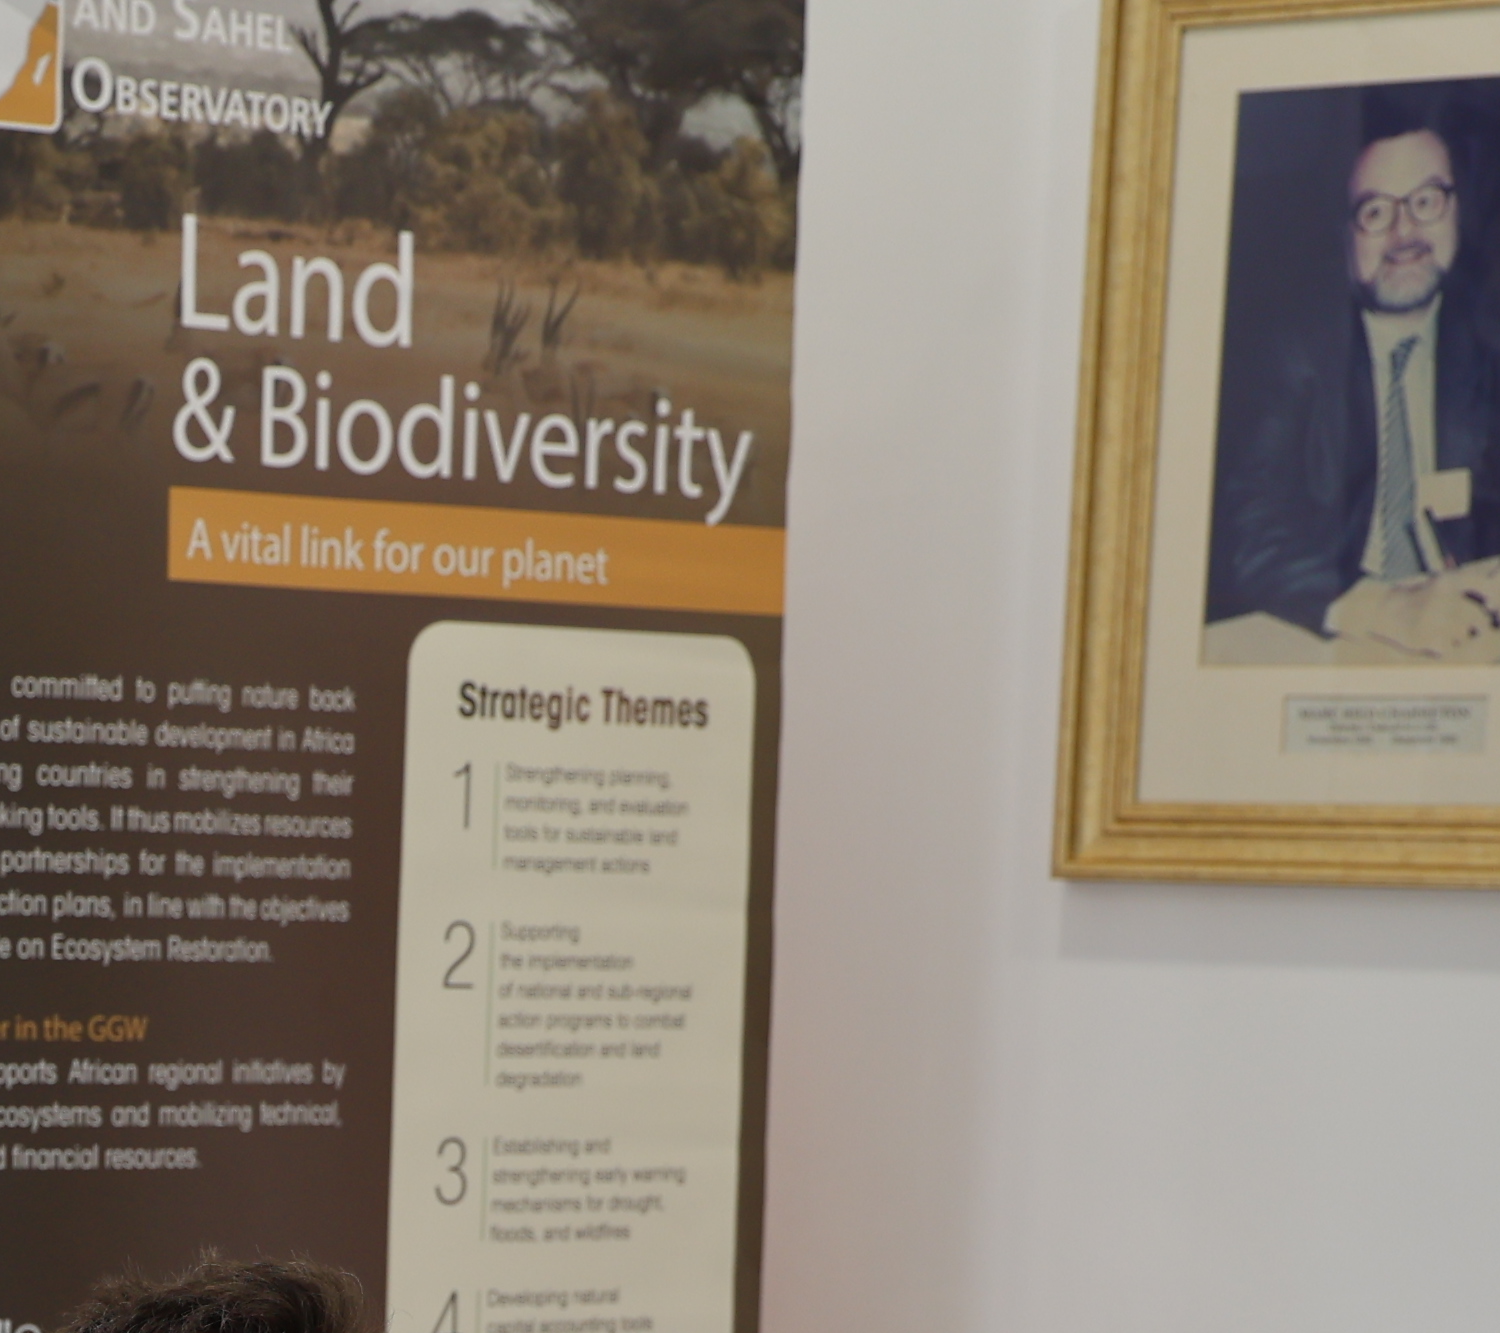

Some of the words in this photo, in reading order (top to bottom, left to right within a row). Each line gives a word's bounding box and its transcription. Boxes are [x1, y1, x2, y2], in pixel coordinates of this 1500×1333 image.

[72, 0, 158, 36] AND
[173, 0, 293, 53] SAHEL
[70, 56, 334, 139] OBSERVATORY
[181, 213, 415, 349] Land
[173, 358, 235, 465] &
[259, 367, 753, 526] Biodiversity
[185, 517, 213, 561] A
[220, 521, 292, 566] vital
[300, 523, 366, 571] link
[373, 528, 425, 574] for
[432, 541, 495, 577] our
[502, 537, 610, 589] planet
[10, 671, 124, 700] committed
[134, 676, 156, 702] to
[165, 679, 232, 712] putting
[240, 683, 300, 709] nature
[307, 685, 356, 711] back
[458, 681, 590, 729] Strategic
[601, 688, 709, 727] Themes
[26, 716, 149, 745] sustainable
[153, 721, 273, 752] development
[276, 729, 296, 750] in
[300, 726, 355, 753] Africa
[35, 760, 133, 788] countries
[145, 763, 166, 787] in
[177, 765, 301, 800] strengthening
[310, 771, 354, 795] their
[452, 760, 473, 831] 1
[110, 806, 124, 828] It
[126, 807, 170, 832] thus
[172, 807, 261, 835] mobilizes
[263, 814, 352, 838] resources
[0, 846, 130, 877] partnerships
[138, 849, 166, 875] for
[173, 851, 205, 875] the
[211, 852, 351, 882] implementation
[122, 892, 143, 915] in
[146, 893, 183, 918] line
[185, 894, 225, 917] with
[227, 895, 257, 919] the
[258, 896, 350, 926] objectives
[15, 937, 44, 959] on
[50, 933, 162, 964] Ecosystem
[442, 919, 476, 990] 2
[14, 1015, 37, 1039] in
[42, 1014, 83, 1041] the
[86, 1015, 148, 1041] GGW
[67, 1058, 138, 1083] African
[147, 1060, 224, 1090] regional
[230, 1060, 314, 1083] initiatives
[320, 1060, 346, 1086] by
[109, 1103, 150, 1126] and
[157, 1102, 253, 1132] mobilizing
[10, 1144, 99, 1169] financial
[434, 1136, 469, 1206] 3
